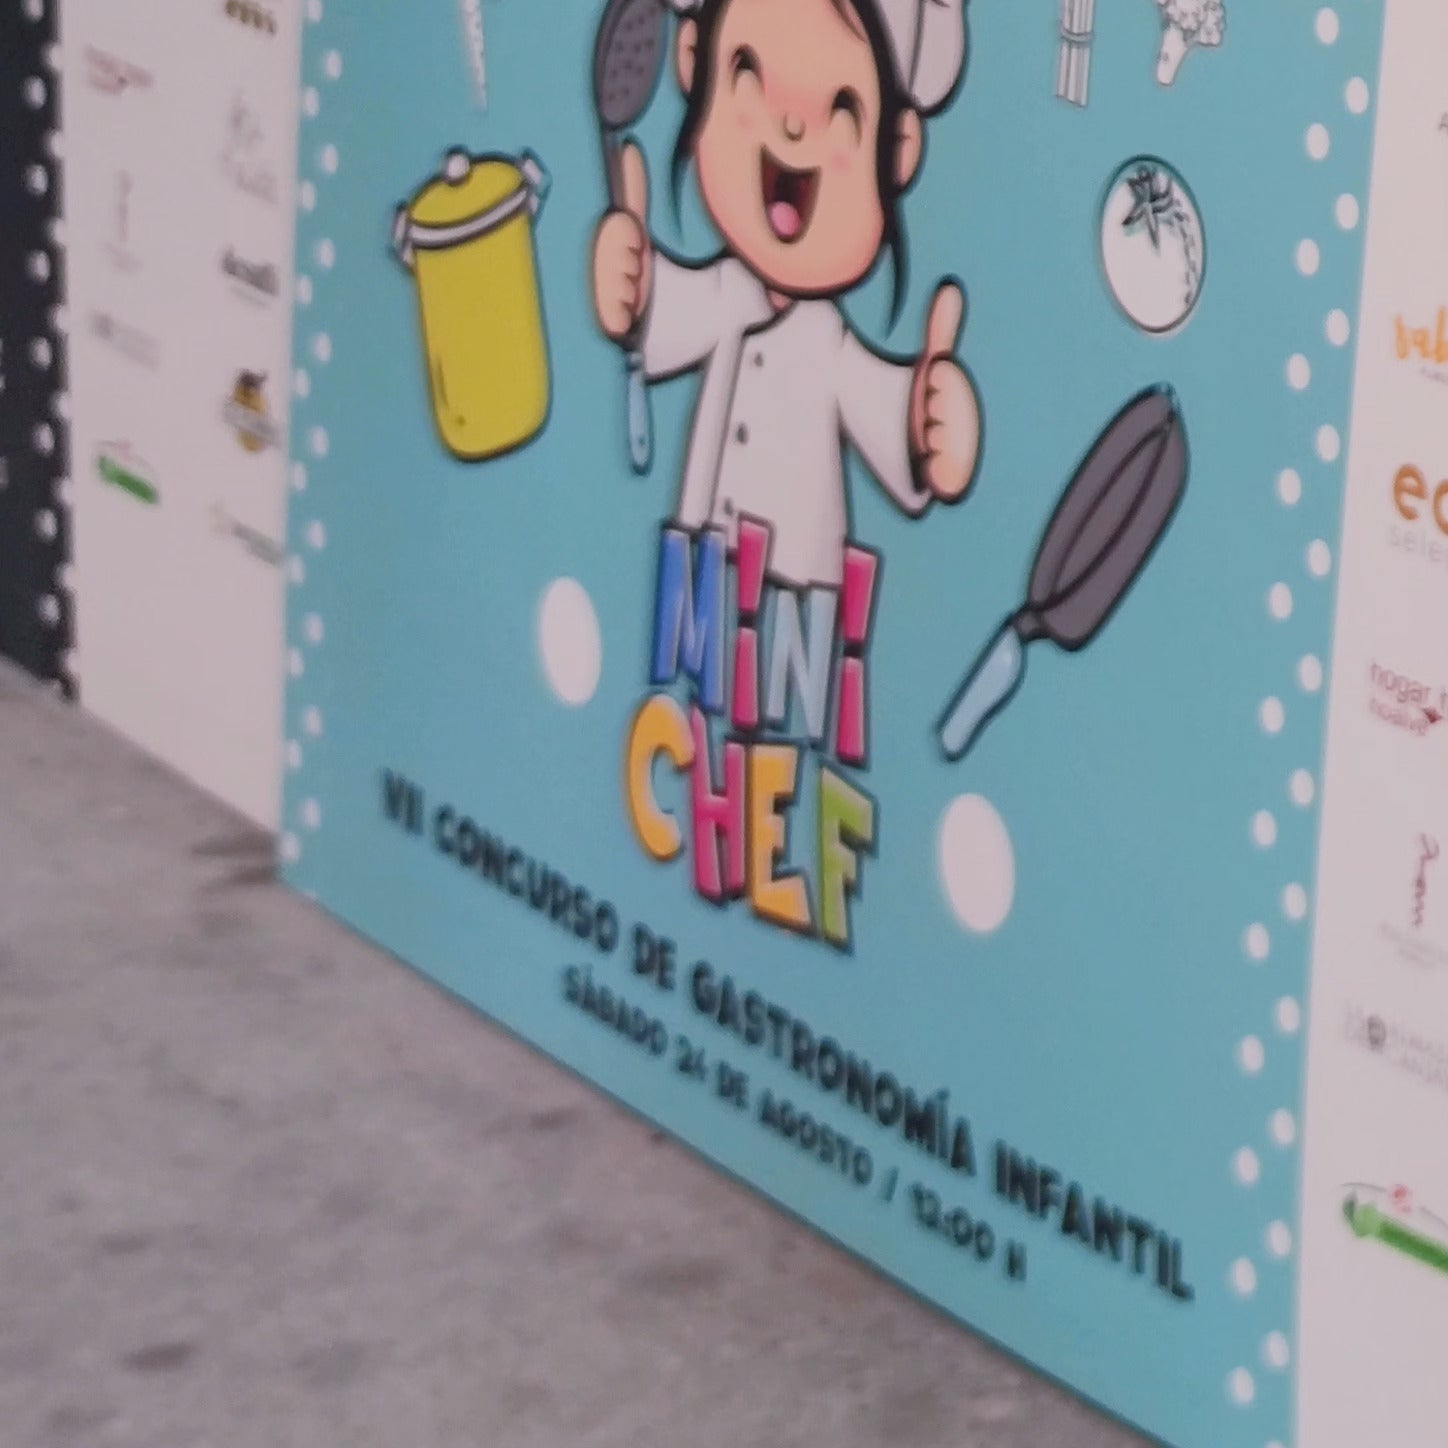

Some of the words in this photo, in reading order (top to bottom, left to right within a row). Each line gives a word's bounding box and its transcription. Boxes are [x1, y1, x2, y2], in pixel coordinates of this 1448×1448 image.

[622, 692, 880, 954] CHEF
[434, 803, 619, 955] CONCURSO
[632, 920, 678, 992] DE
[689, 957, 977, 1177] GASTRONOMÍA
[995, 1137, 1196, 1303] INFANTIL
[560, 960, 669, 1058] SÁBADO
[716, 1060, 750, 1110] DE
[757, 1088, 874, 1187] AGOSTO
[907, 1181, 996, 1263] 12:00
